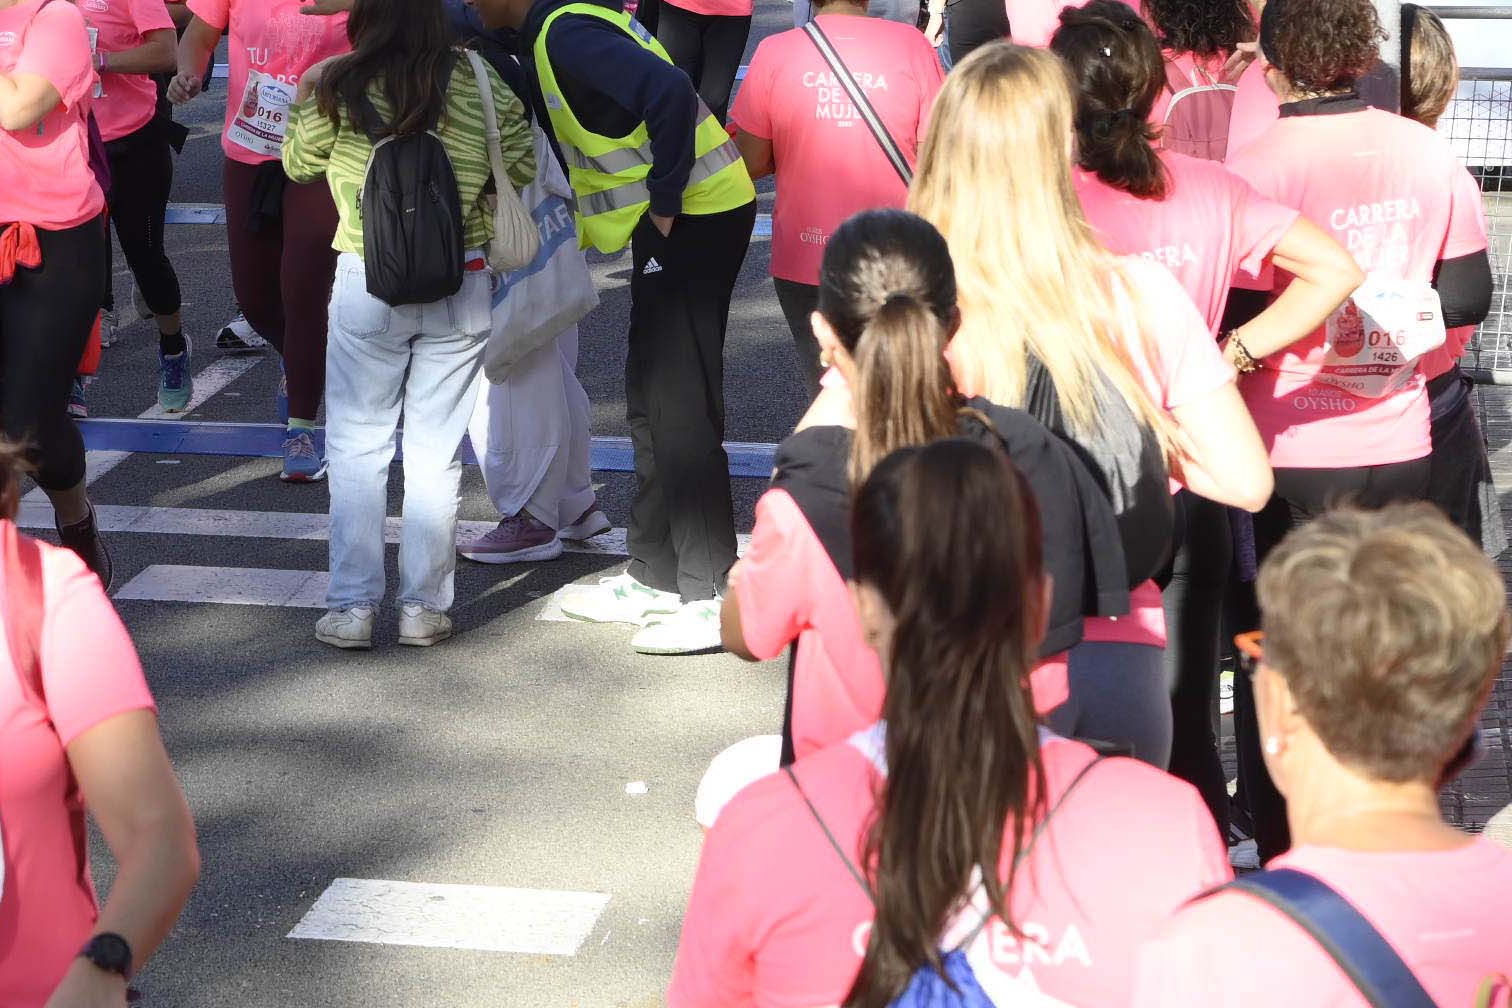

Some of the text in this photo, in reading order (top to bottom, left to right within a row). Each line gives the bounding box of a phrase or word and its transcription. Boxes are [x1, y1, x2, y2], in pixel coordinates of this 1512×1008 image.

[247, 47, 268, 65] TU
[818, 87, 841, 103] DE
[257, 105, 282, 122] 016
[1331, 198, 1420, 231] CARRERA
[643, 266, 663, 275] adidas
[1368, 330, 1406, 347] 016
[1372, 352, 1398, 362] 1426
[1294, 393, 1356, 412] OYSHO
